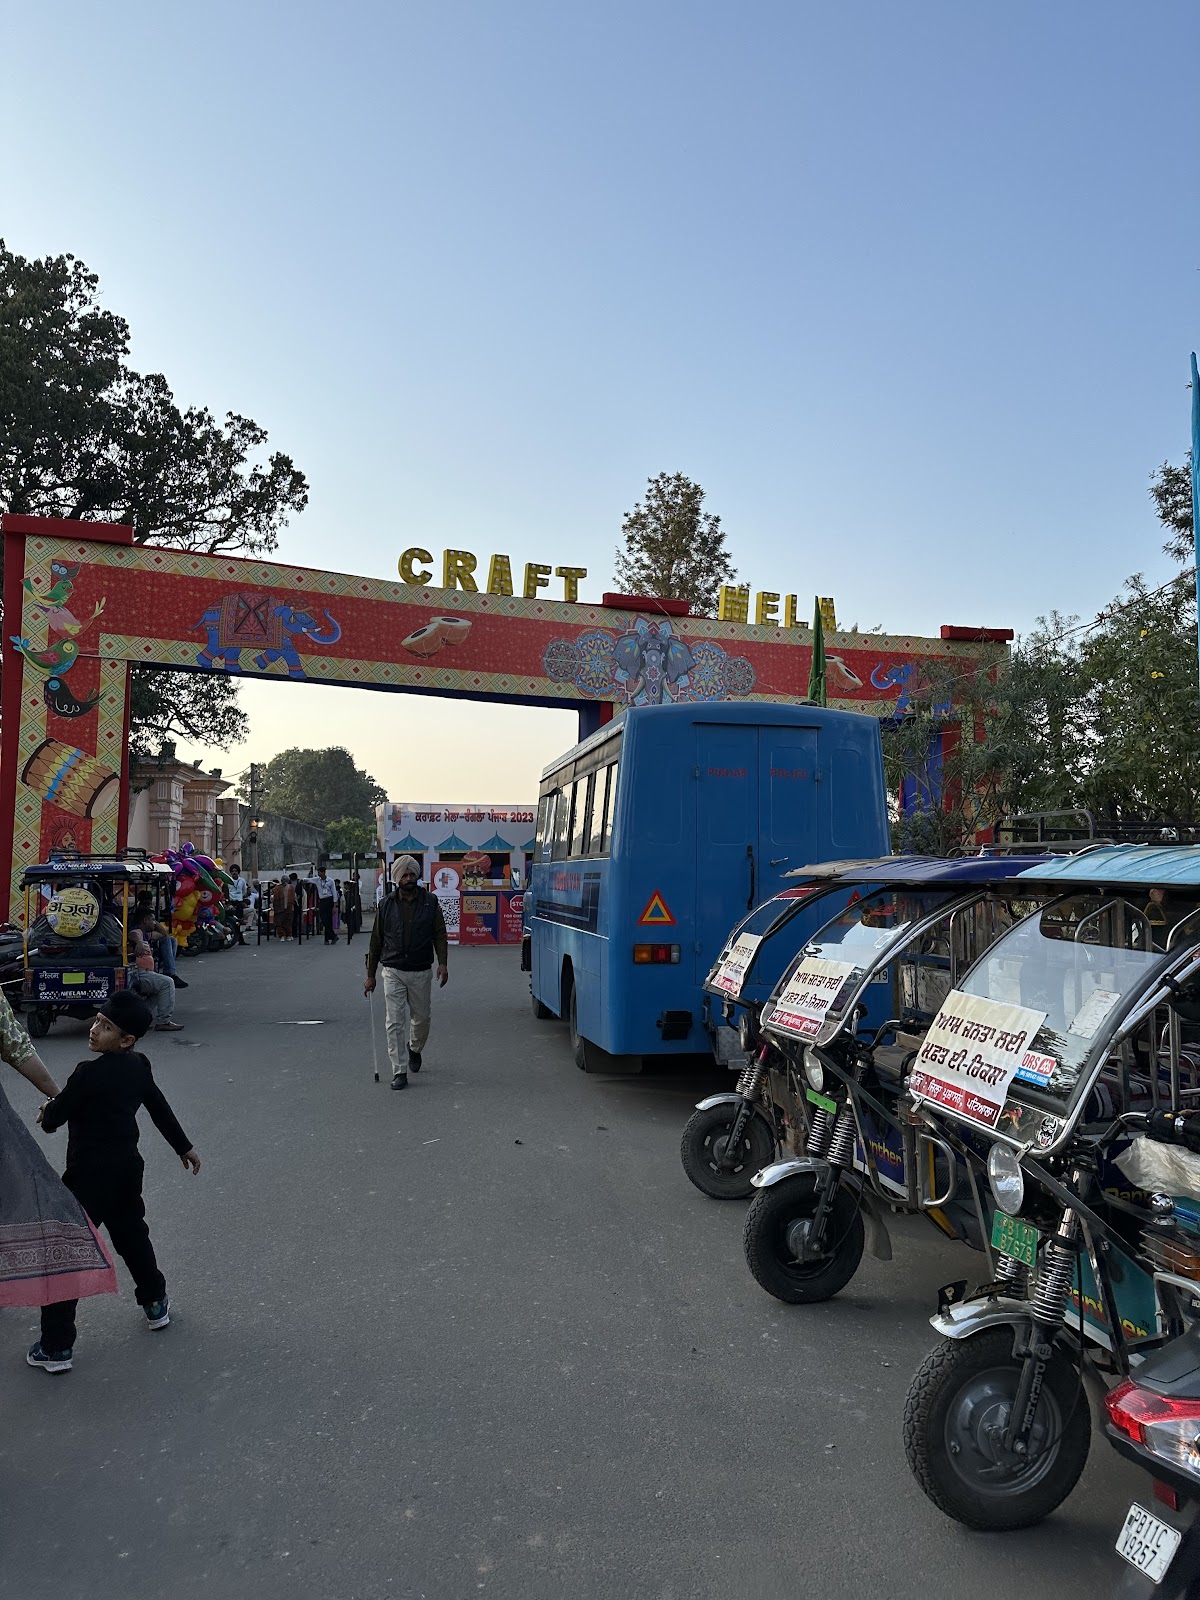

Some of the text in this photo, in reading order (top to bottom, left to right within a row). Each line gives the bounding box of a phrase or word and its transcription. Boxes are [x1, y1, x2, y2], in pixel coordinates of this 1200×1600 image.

[398, 547, 837, 632] CRAFT MELA
[707, 767, 807, 779] PUNJAB POLICE
[511, 812, 534, 823] 2023
[48, 901, 95, 917] अजूबी
[794, 971, 844, 991] ਆਮ ਜਨਤਾ ਲਈ
[935, 1012, 1028, 1054] ਆਮ ਜਨਤਾ ਲਈ
[858, 1140, 902, 1167] nther
[1131, 1511, 1168, 1548] PB11C
